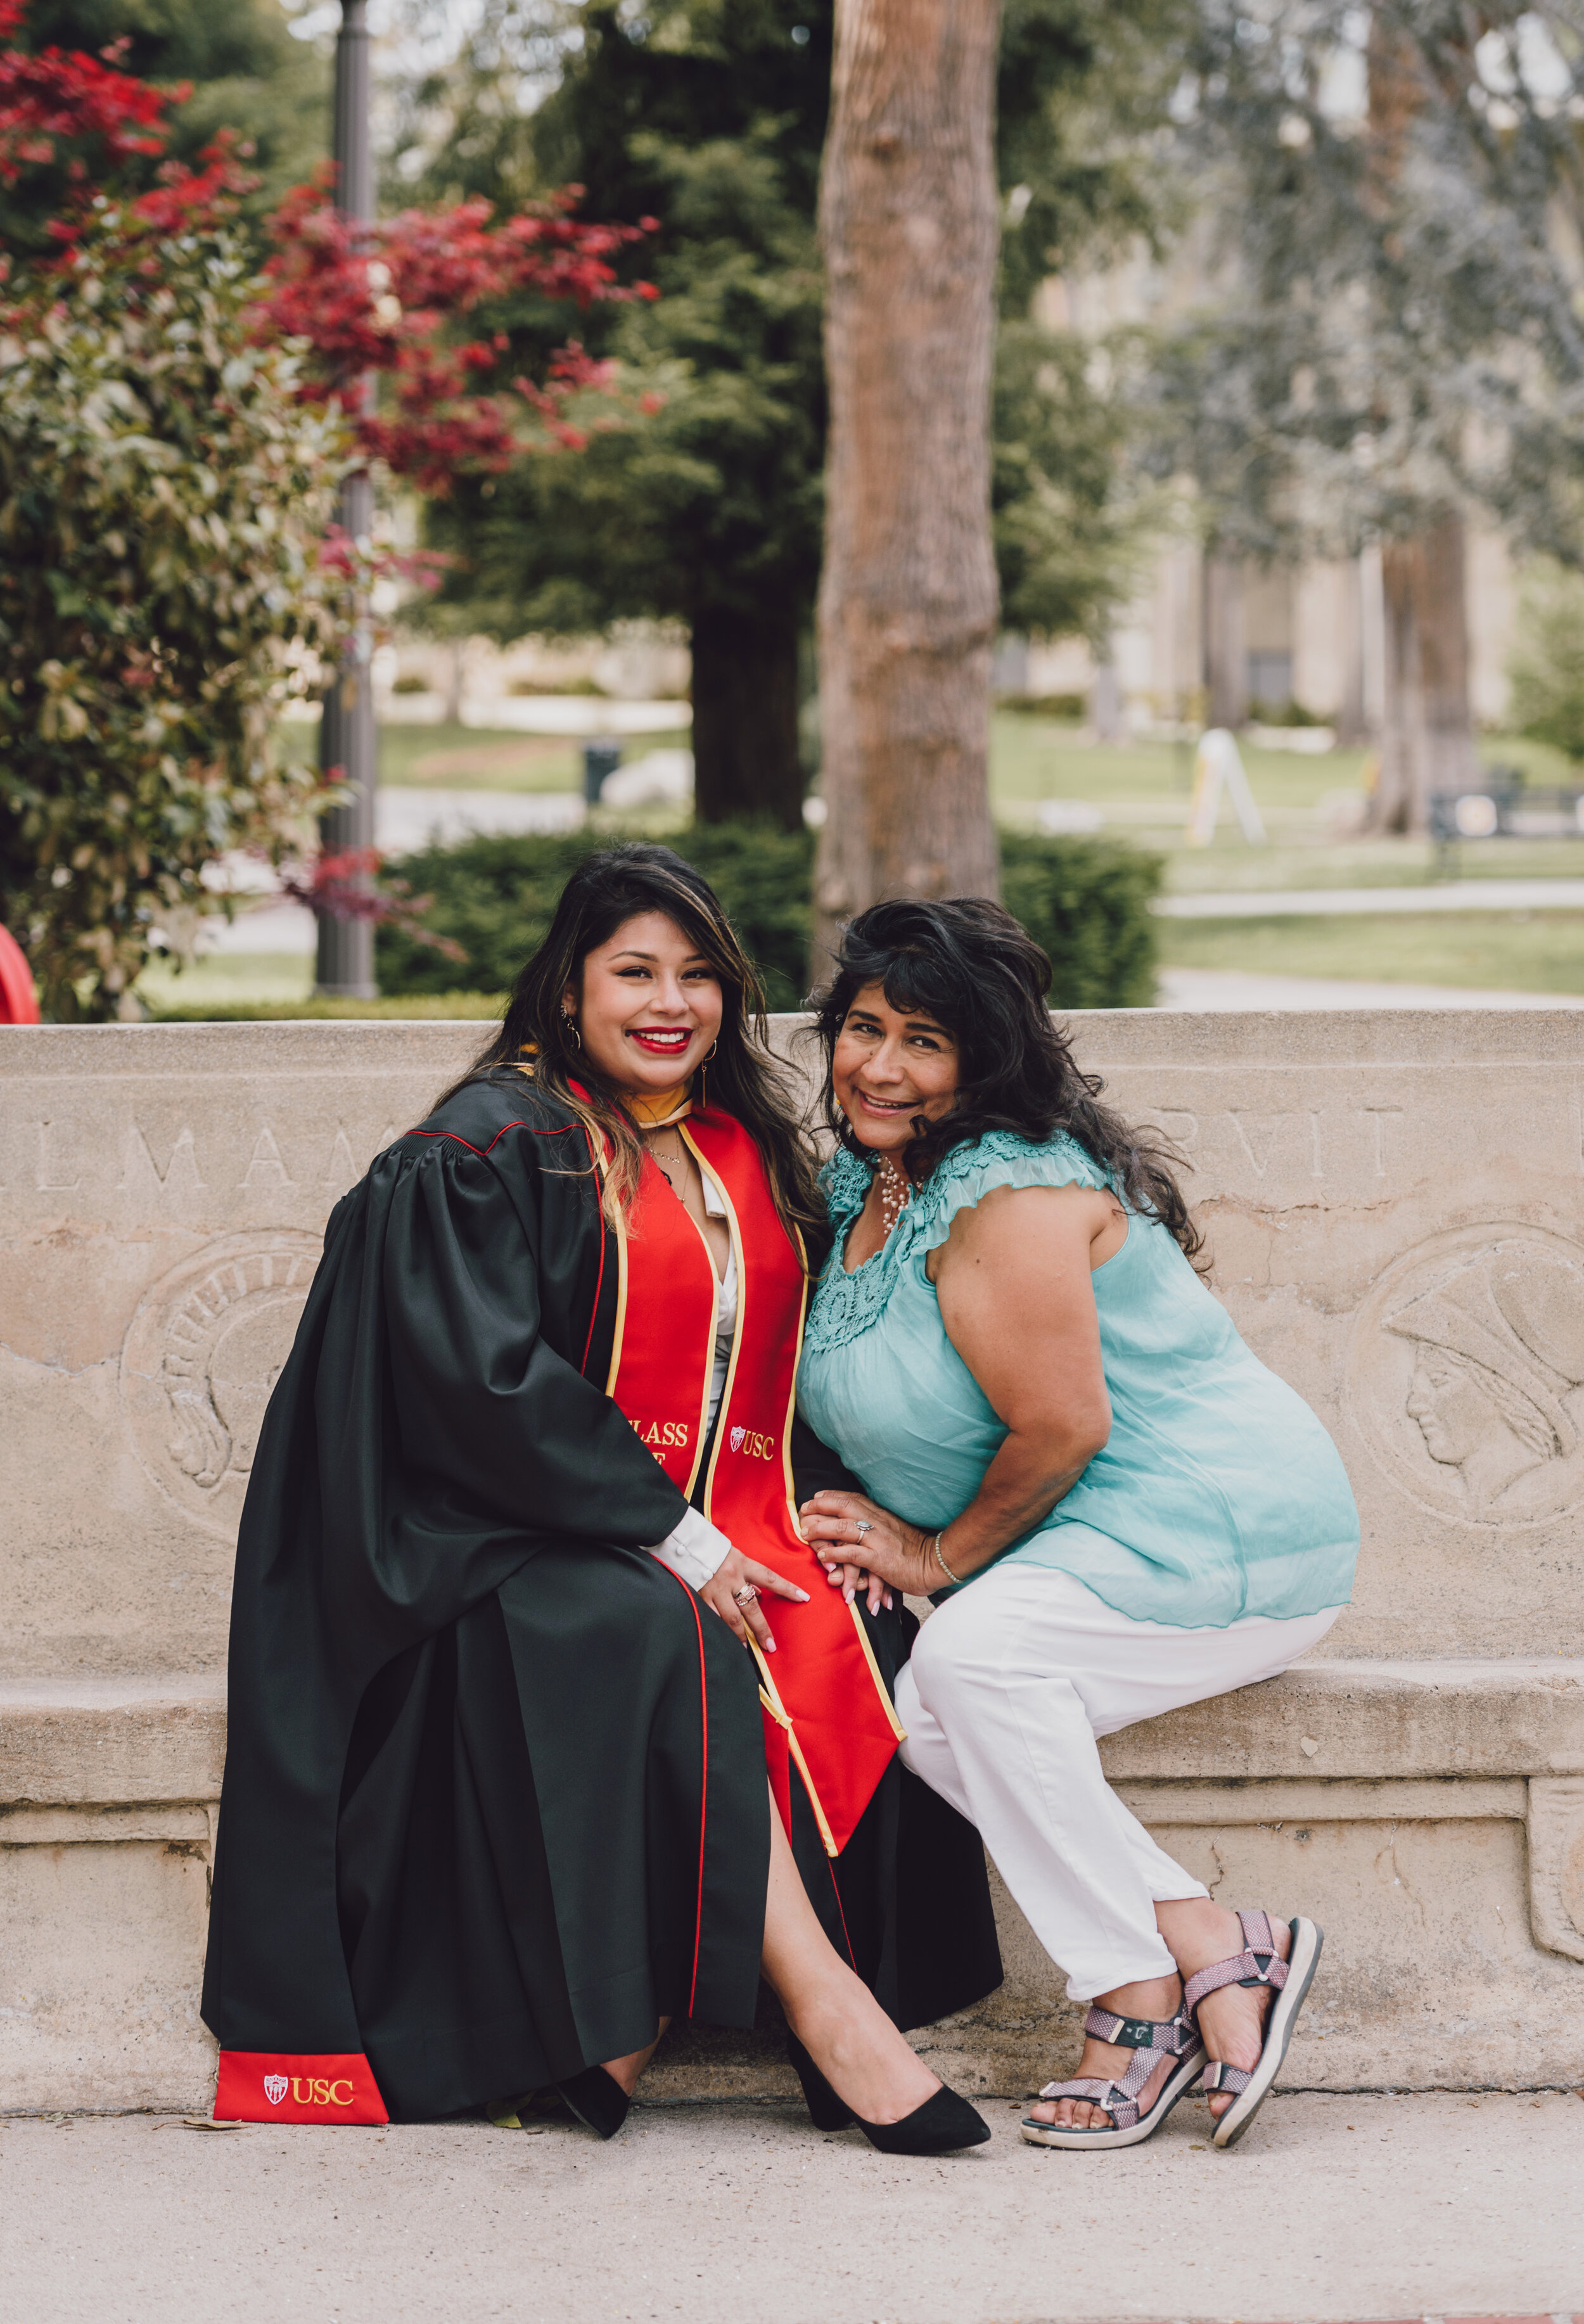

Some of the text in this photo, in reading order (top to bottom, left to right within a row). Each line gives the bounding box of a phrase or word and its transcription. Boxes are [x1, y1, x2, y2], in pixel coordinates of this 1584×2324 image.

[628, 1420, 688, 1447] LASS
[743, 1431, 774, 1460] USC
[290, 2078, 354, 2106] USC
